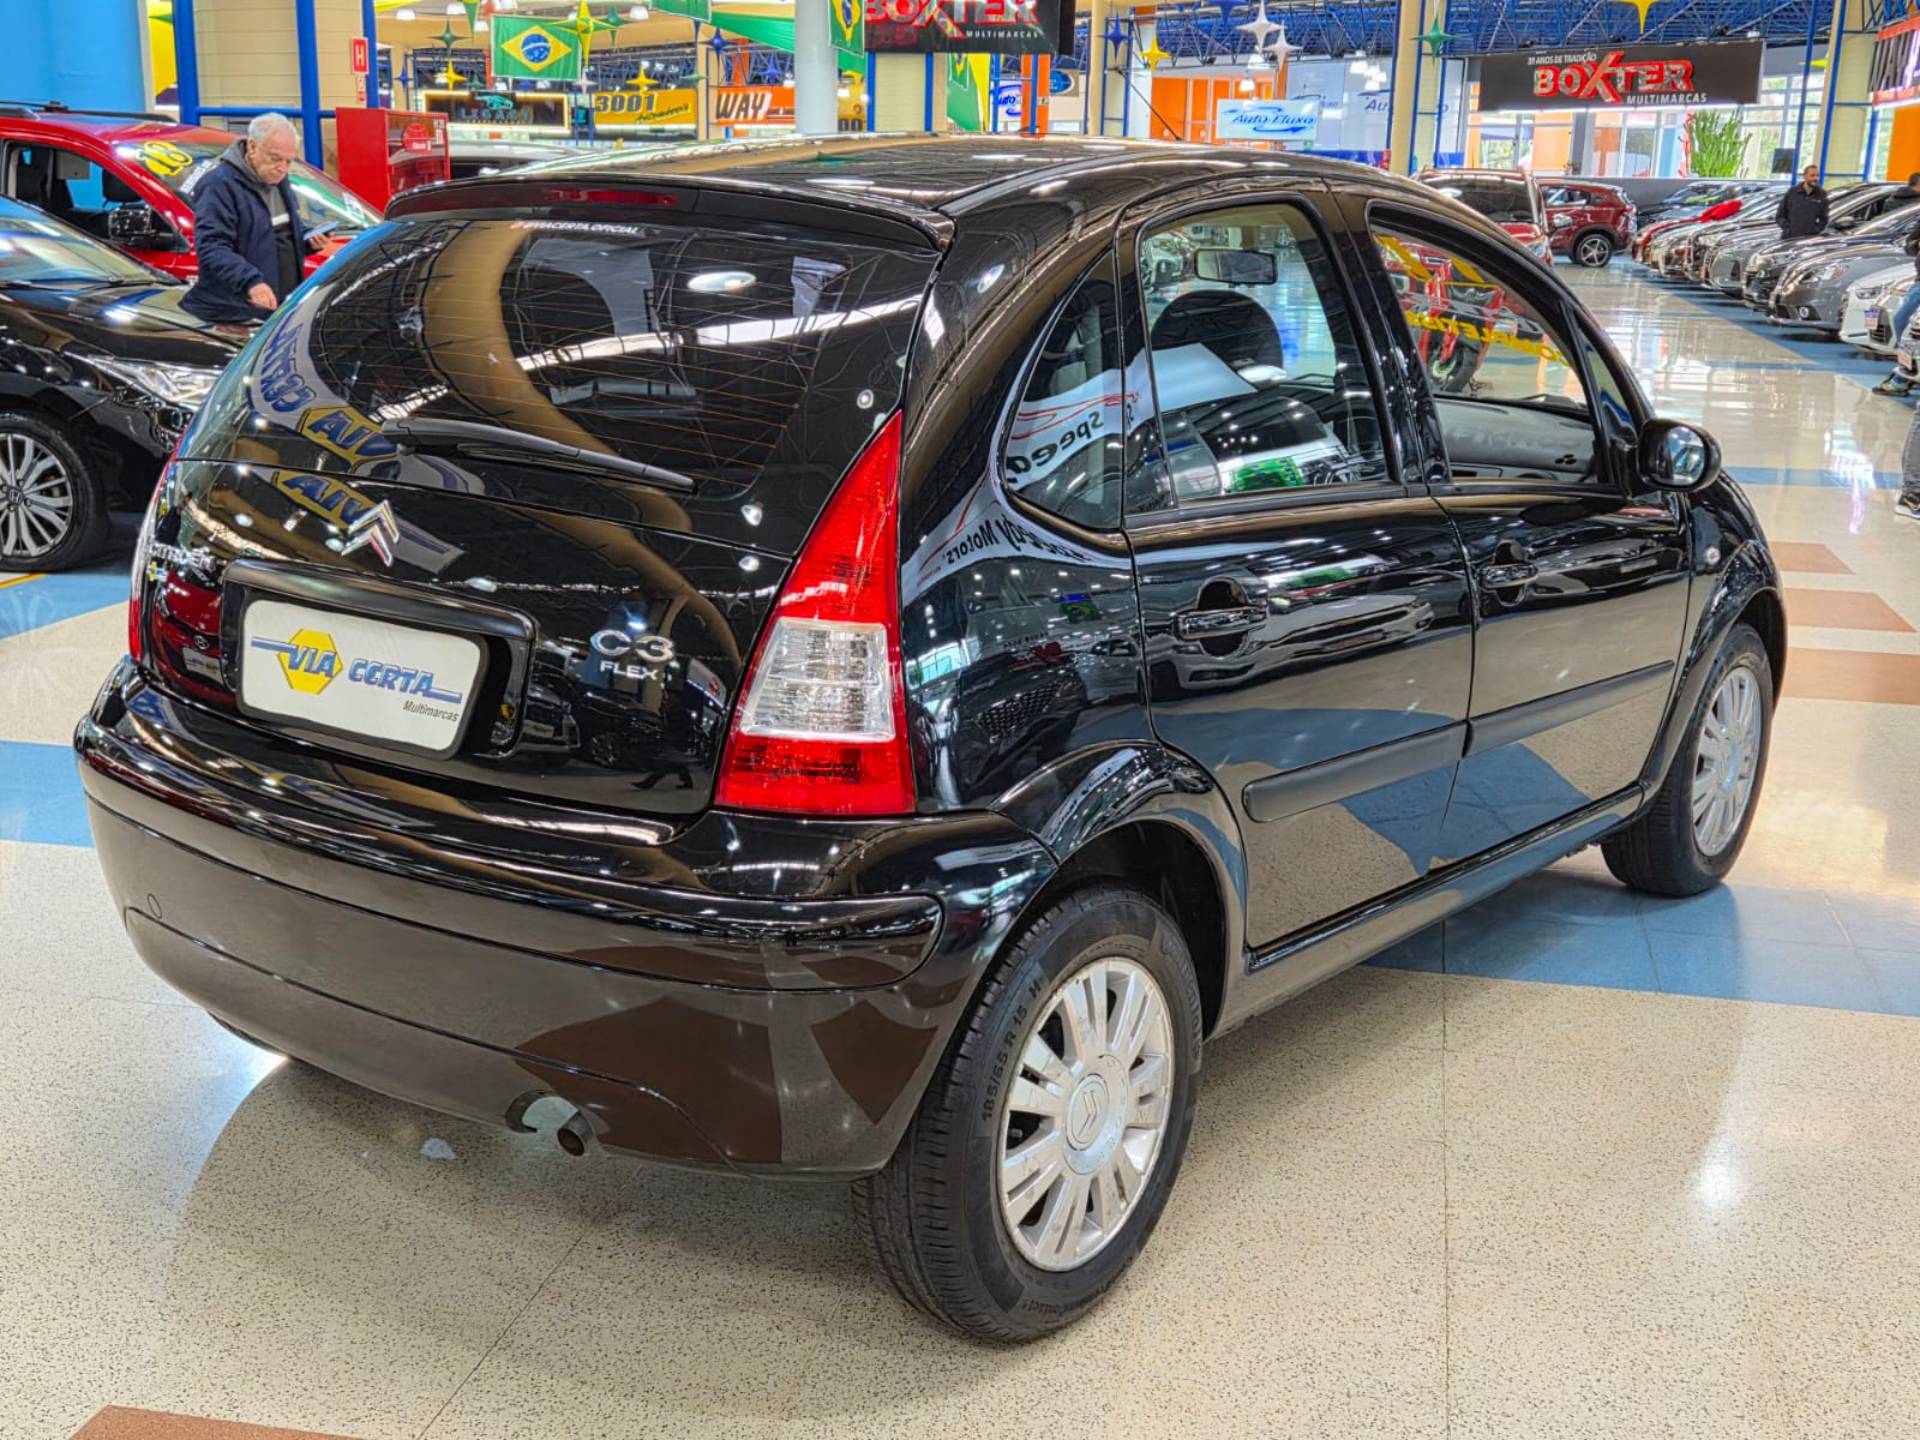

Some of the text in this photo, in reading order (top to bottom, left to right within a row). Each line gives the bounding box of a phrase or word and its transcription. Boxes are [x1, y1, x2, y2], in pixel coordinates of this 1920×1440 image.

[965, 29, 1039, 39] MULTIMARCAS
[1533, 50, 1695, 105] BOXTER
[595, 94, 656, 113] 3001
[716, 92, 767, 120] WAY
[1626, 92, 1708, 106] MULTIMARCAS
[1232, 114, 1269, 125] Auto
[590, 629, 674, 662] C3
[286, 645, 338, 678] VIA
[600, 660, 658, 680] FLEX
[402, 699, 460, 722] Multimarcas
[1003, 1030, 1017, 1048] R
